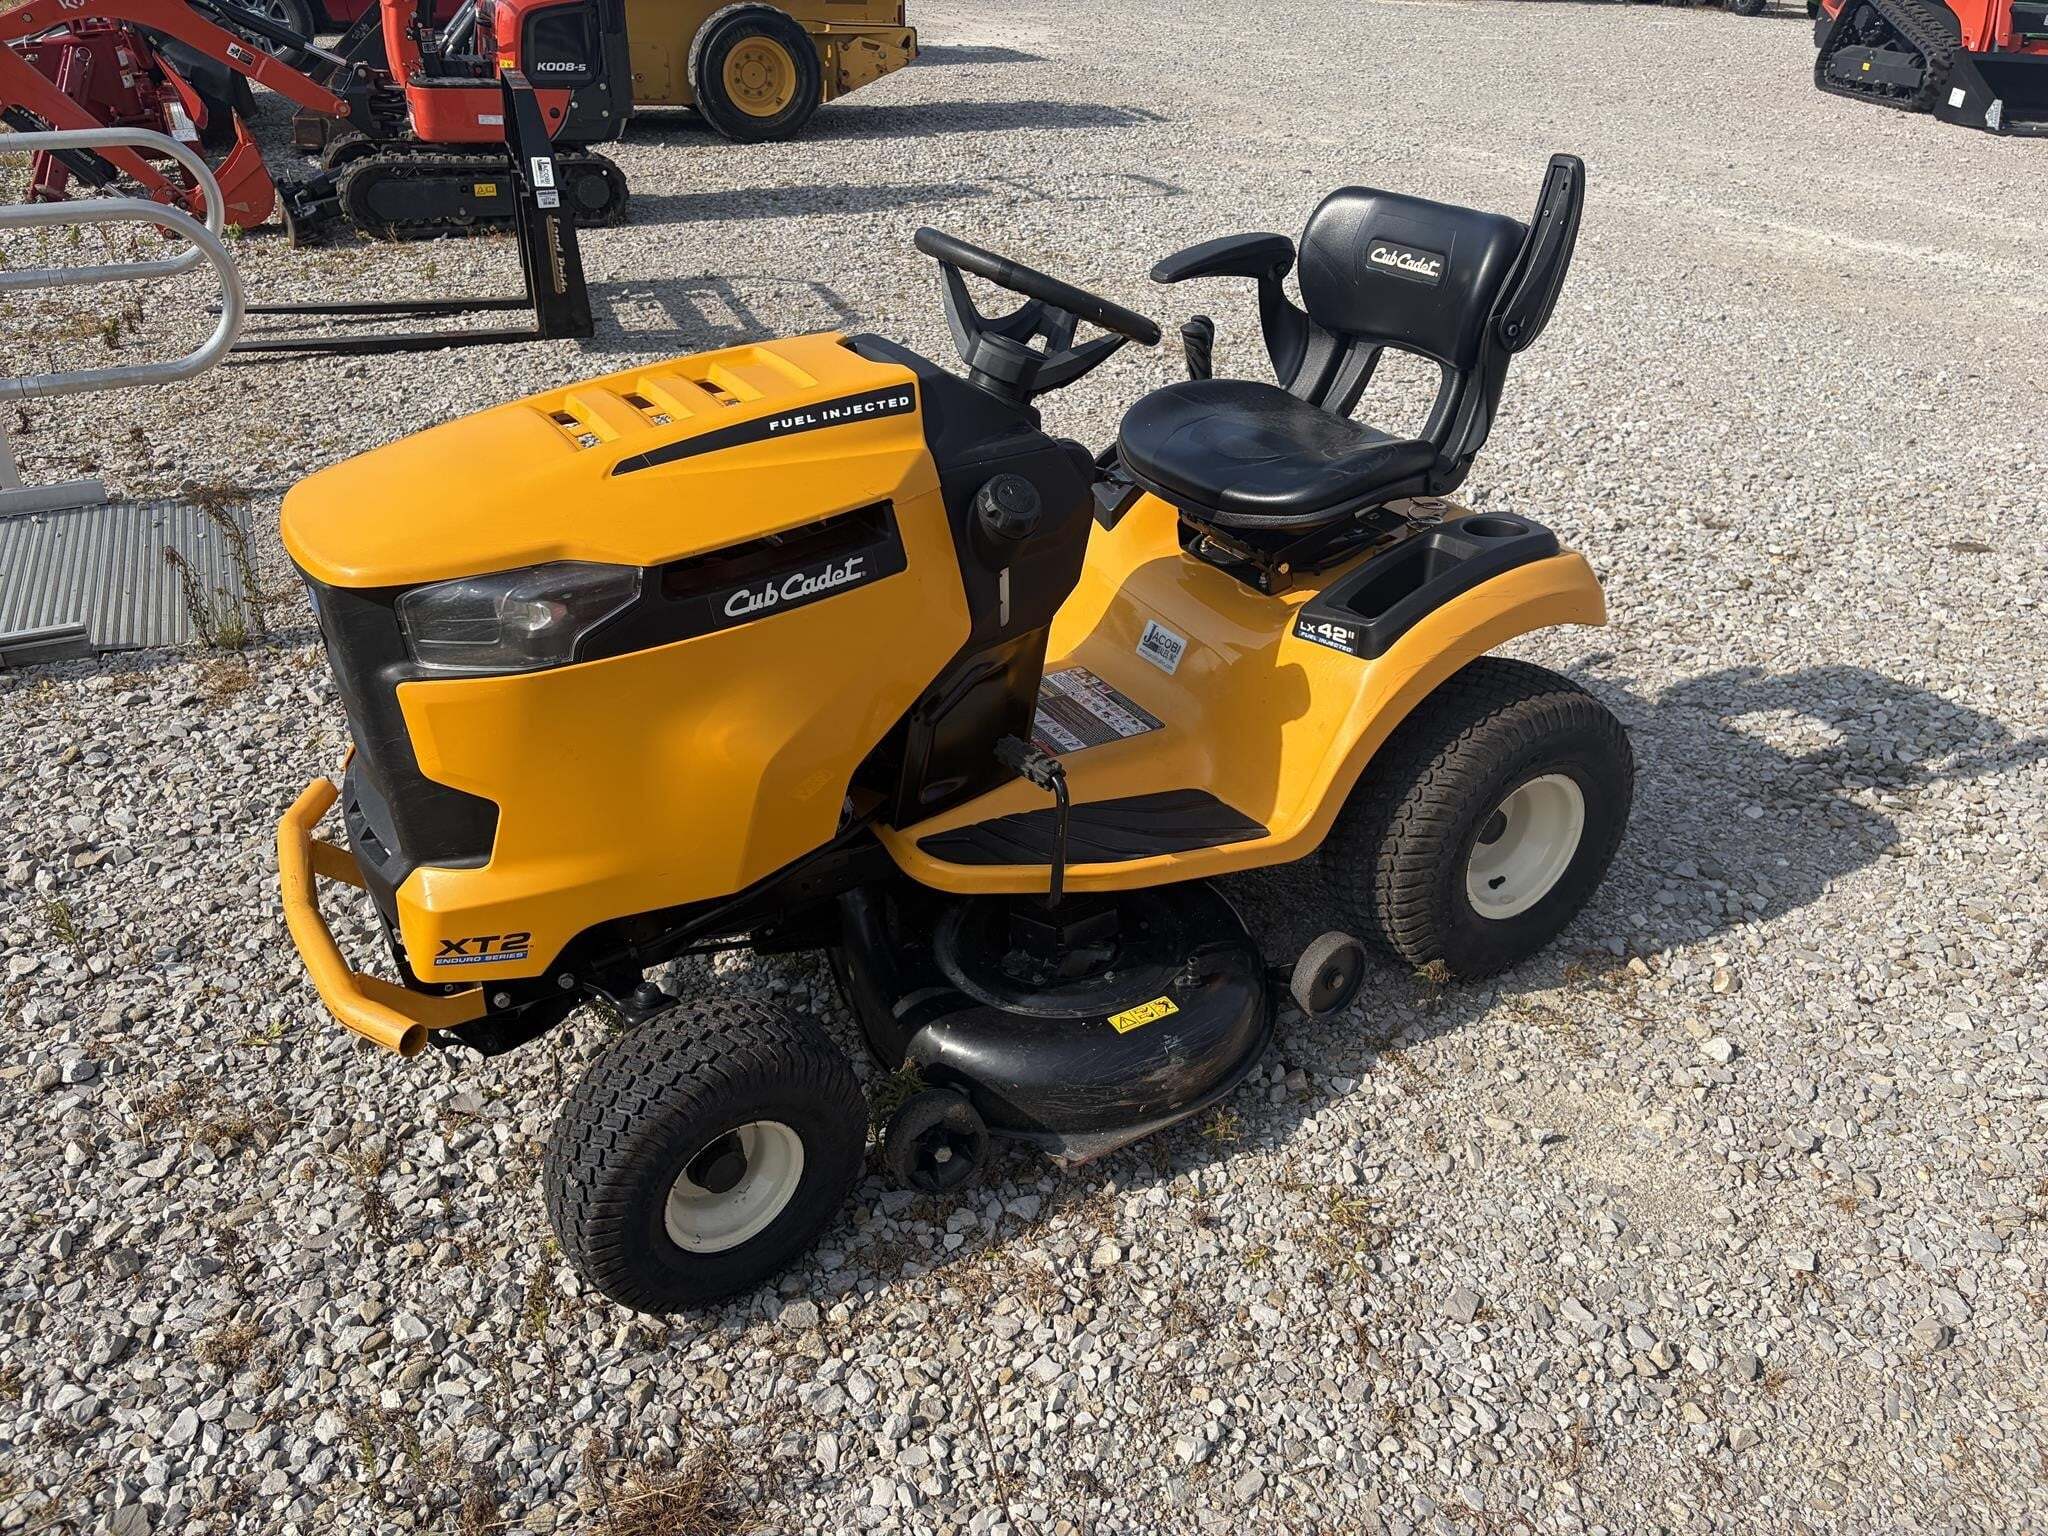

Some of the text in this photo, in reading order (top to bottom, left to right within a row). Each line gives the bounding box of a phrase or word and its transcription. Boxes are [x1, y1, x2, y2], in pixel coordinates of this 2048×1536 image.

[537, 62, 587, 71] K008-5
[769, 396, 910, 431] FUEL INJECTED
[1143, 623, 1182, 655] JACOBI
[1300, 631, 1353, 653] FUEL INJECTED
[435, 932, 531, 957] XT2
[435, 952, 523, 965] ENDURO SERIES
